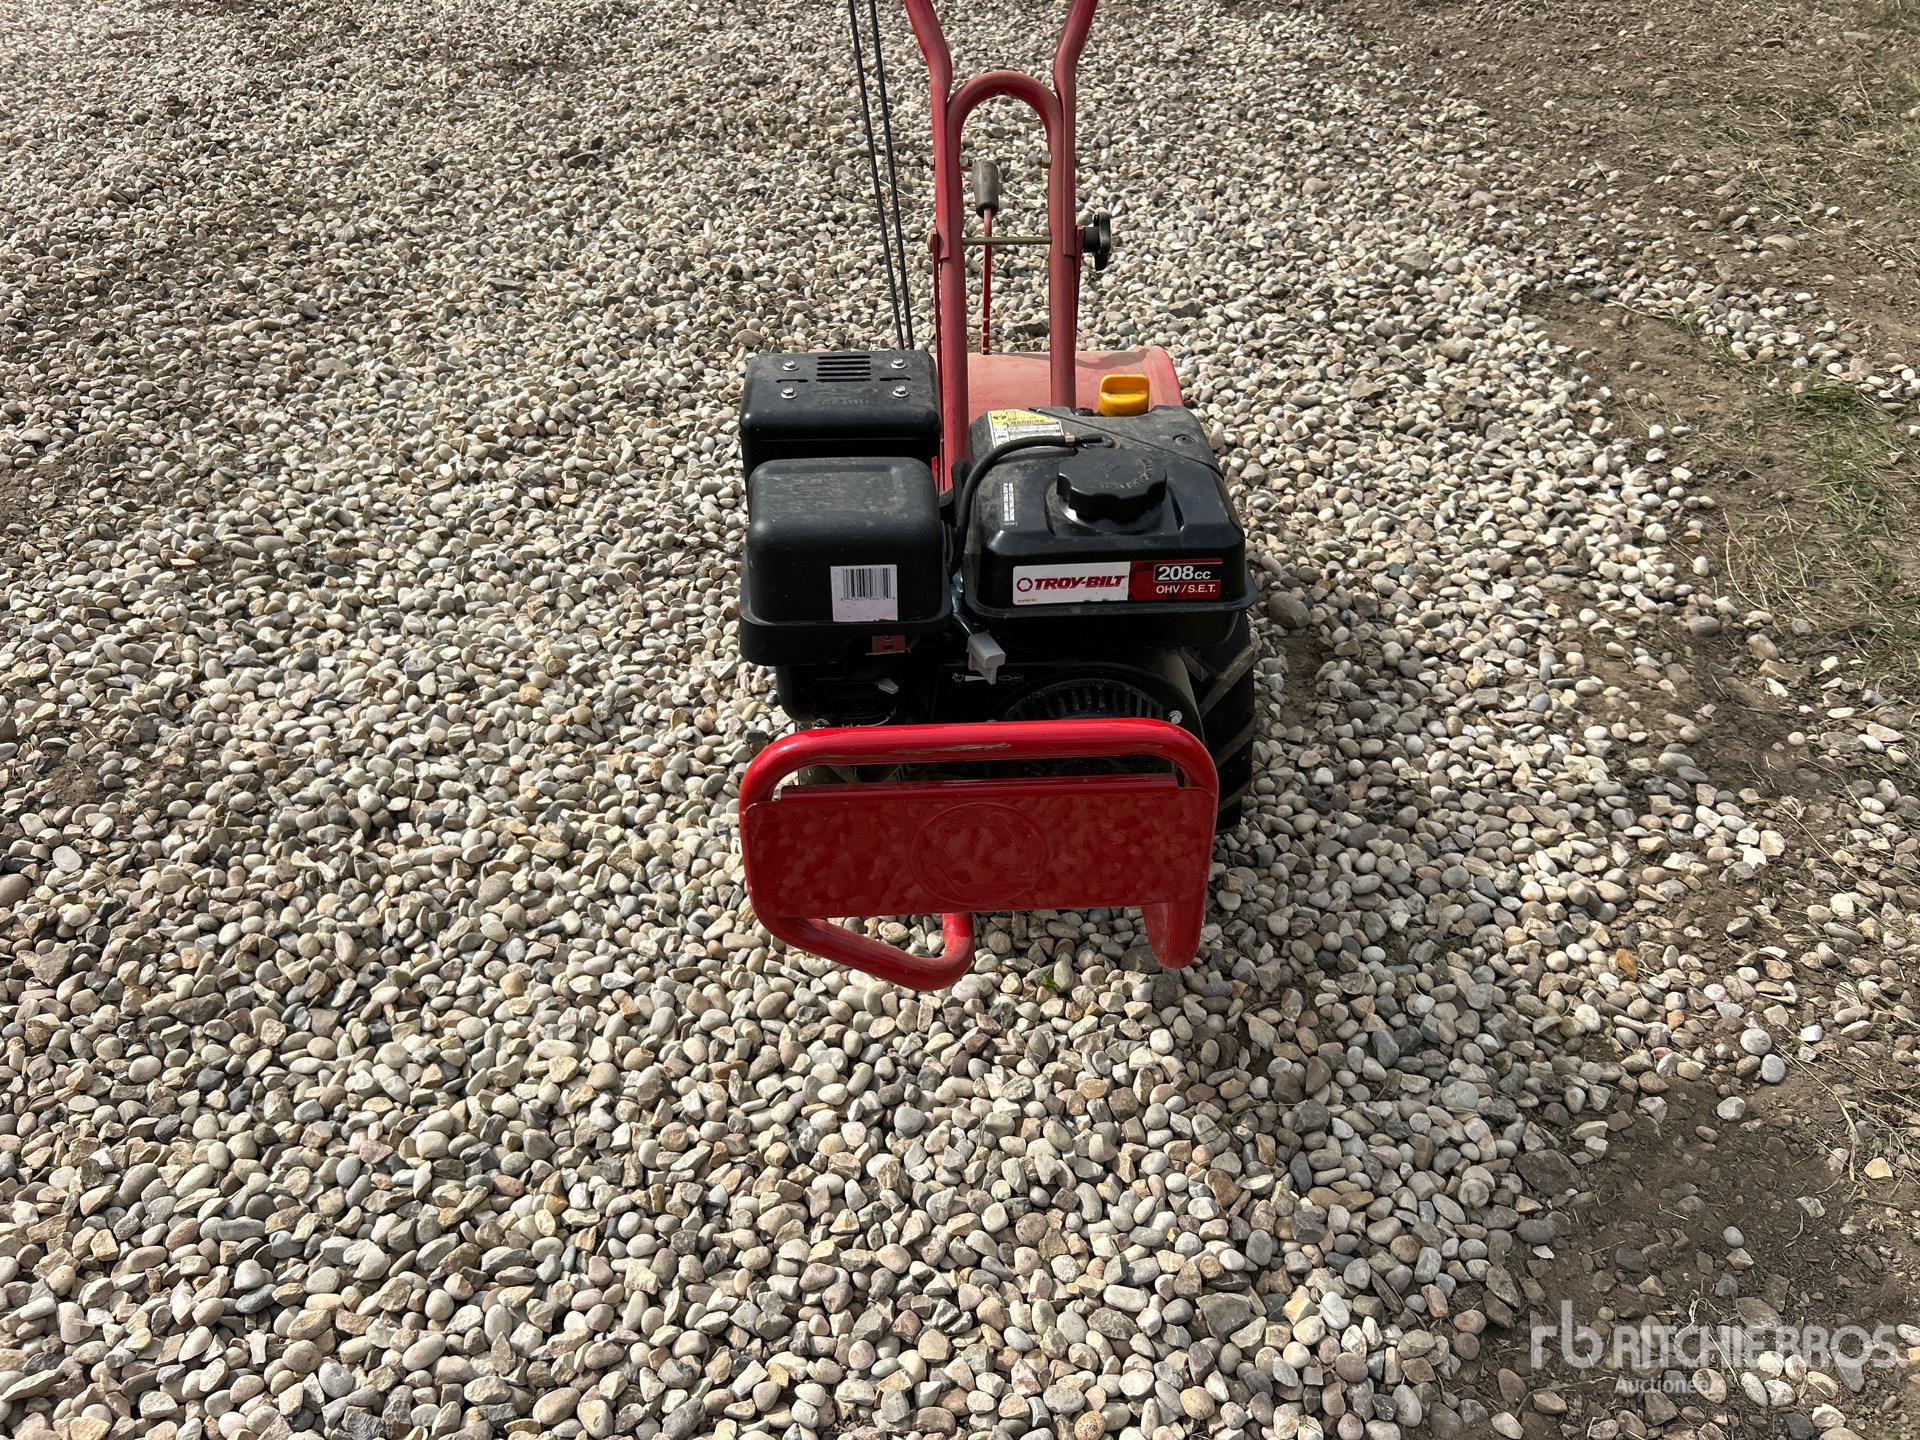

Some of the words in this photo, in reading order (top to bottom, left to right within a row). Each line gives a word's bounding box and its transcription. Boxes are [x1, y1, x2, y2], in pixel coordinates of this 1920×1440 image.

[1035, 575, 1126, 590] TROY-BILT
[1156, 584, 1180, 593] OHV
[1187, 584, 1216, 593] S.E.T.
